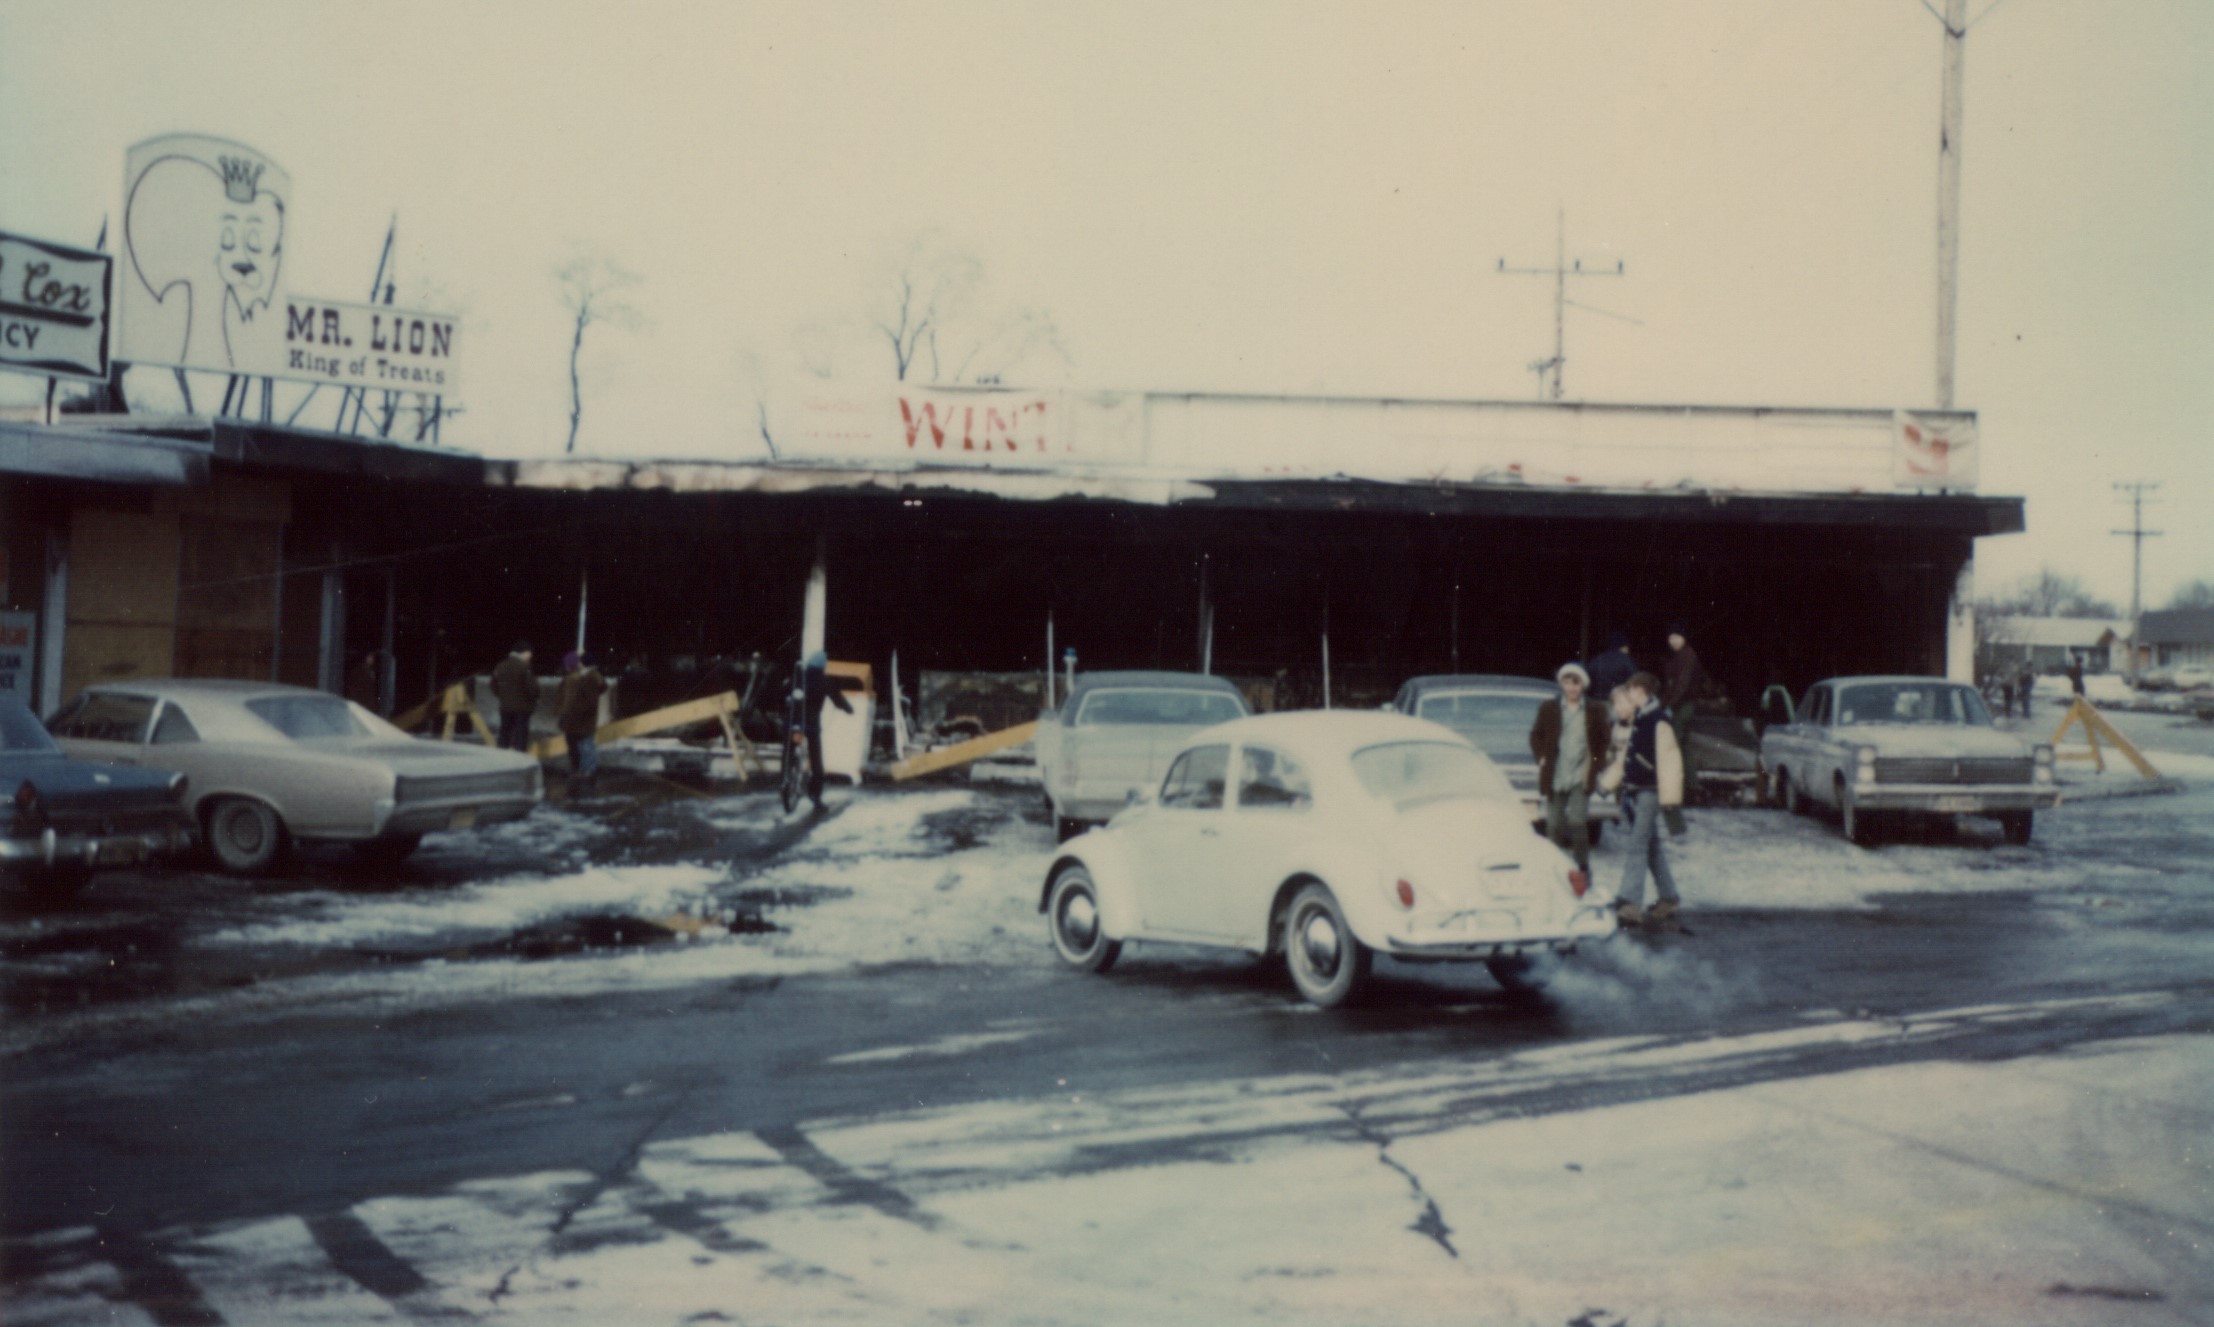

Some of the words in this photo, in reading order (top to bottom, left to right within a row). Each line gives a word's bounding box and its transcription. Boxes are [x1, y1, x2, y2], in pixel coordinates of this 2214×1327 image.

[23, 261, 91, 312] Cox
[0, 321, 40, 350] CY
[286, 304, 353, 347] MR.
[371, 314, 453, 357] LION
[289, 349, 340, 377] King
[349, 357, 367, 376] of
[376, 358, 445, 384] Treats
